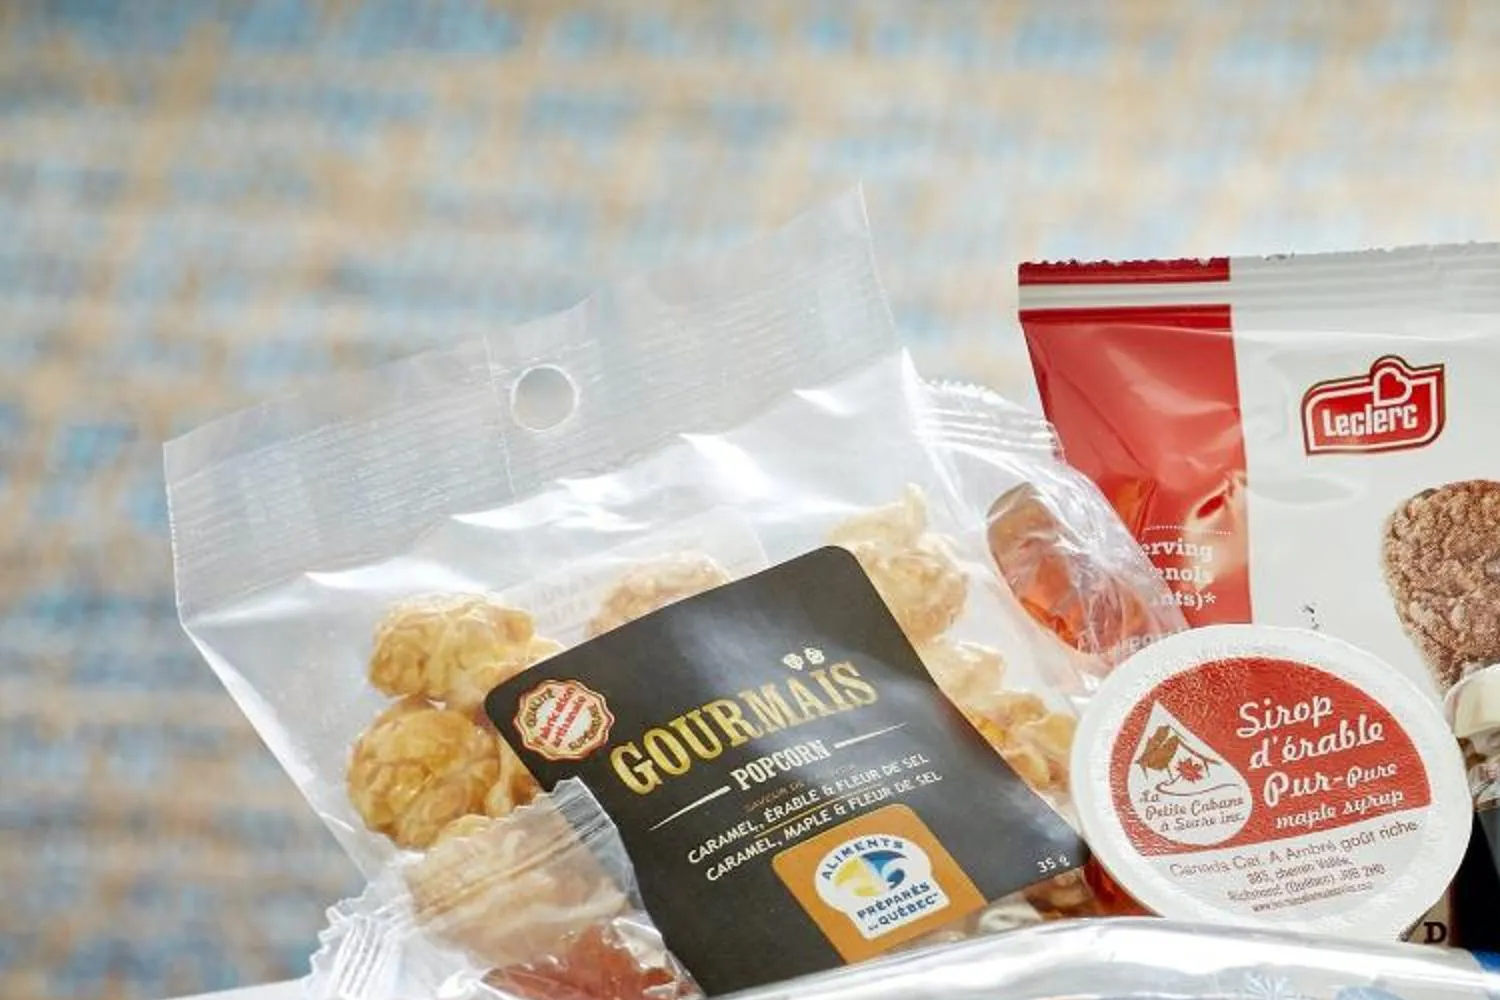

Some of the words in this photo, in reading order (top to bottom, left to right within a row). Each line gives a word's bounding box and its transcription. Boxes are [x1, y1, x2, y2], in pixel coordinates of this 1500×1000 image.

[1322, 403, 1419, 437] Leclerc
[1236, 695, 1333, 738] Sirop
[1248, 713, 1385, 770] d'érable
[729, 739, 833, 792] POPCORN
[686, 818, 765, 864] CARAMEL,
[763, 789, 821, 824] ÉRABLE
[820, 784, 836, 797] &
[835, 767, 882, 794] FLEUR
[881, 759, 902, 777] DE
[902, 752, 930, 770] SEL
[705, 834, 784, 882] CARAMEL,
[782, 809, 833, 842] MAPLE
[833, 803, 847, 816] &
[848, 787, 895, 812] FLEUR
[895, 779, 915, 794] DE
[915, 770, 944, 787] SEL
[1275, 803, 1337, 829] maple
[1342, 790, 1404, 816] syrup
[1378, 819, 1419, 841] riche
[820, 837, 905, 881] ALIMENTS
[1036, 857, 1056, 874] 35
[856, 881, 931, 919] PRÉPARÉS
